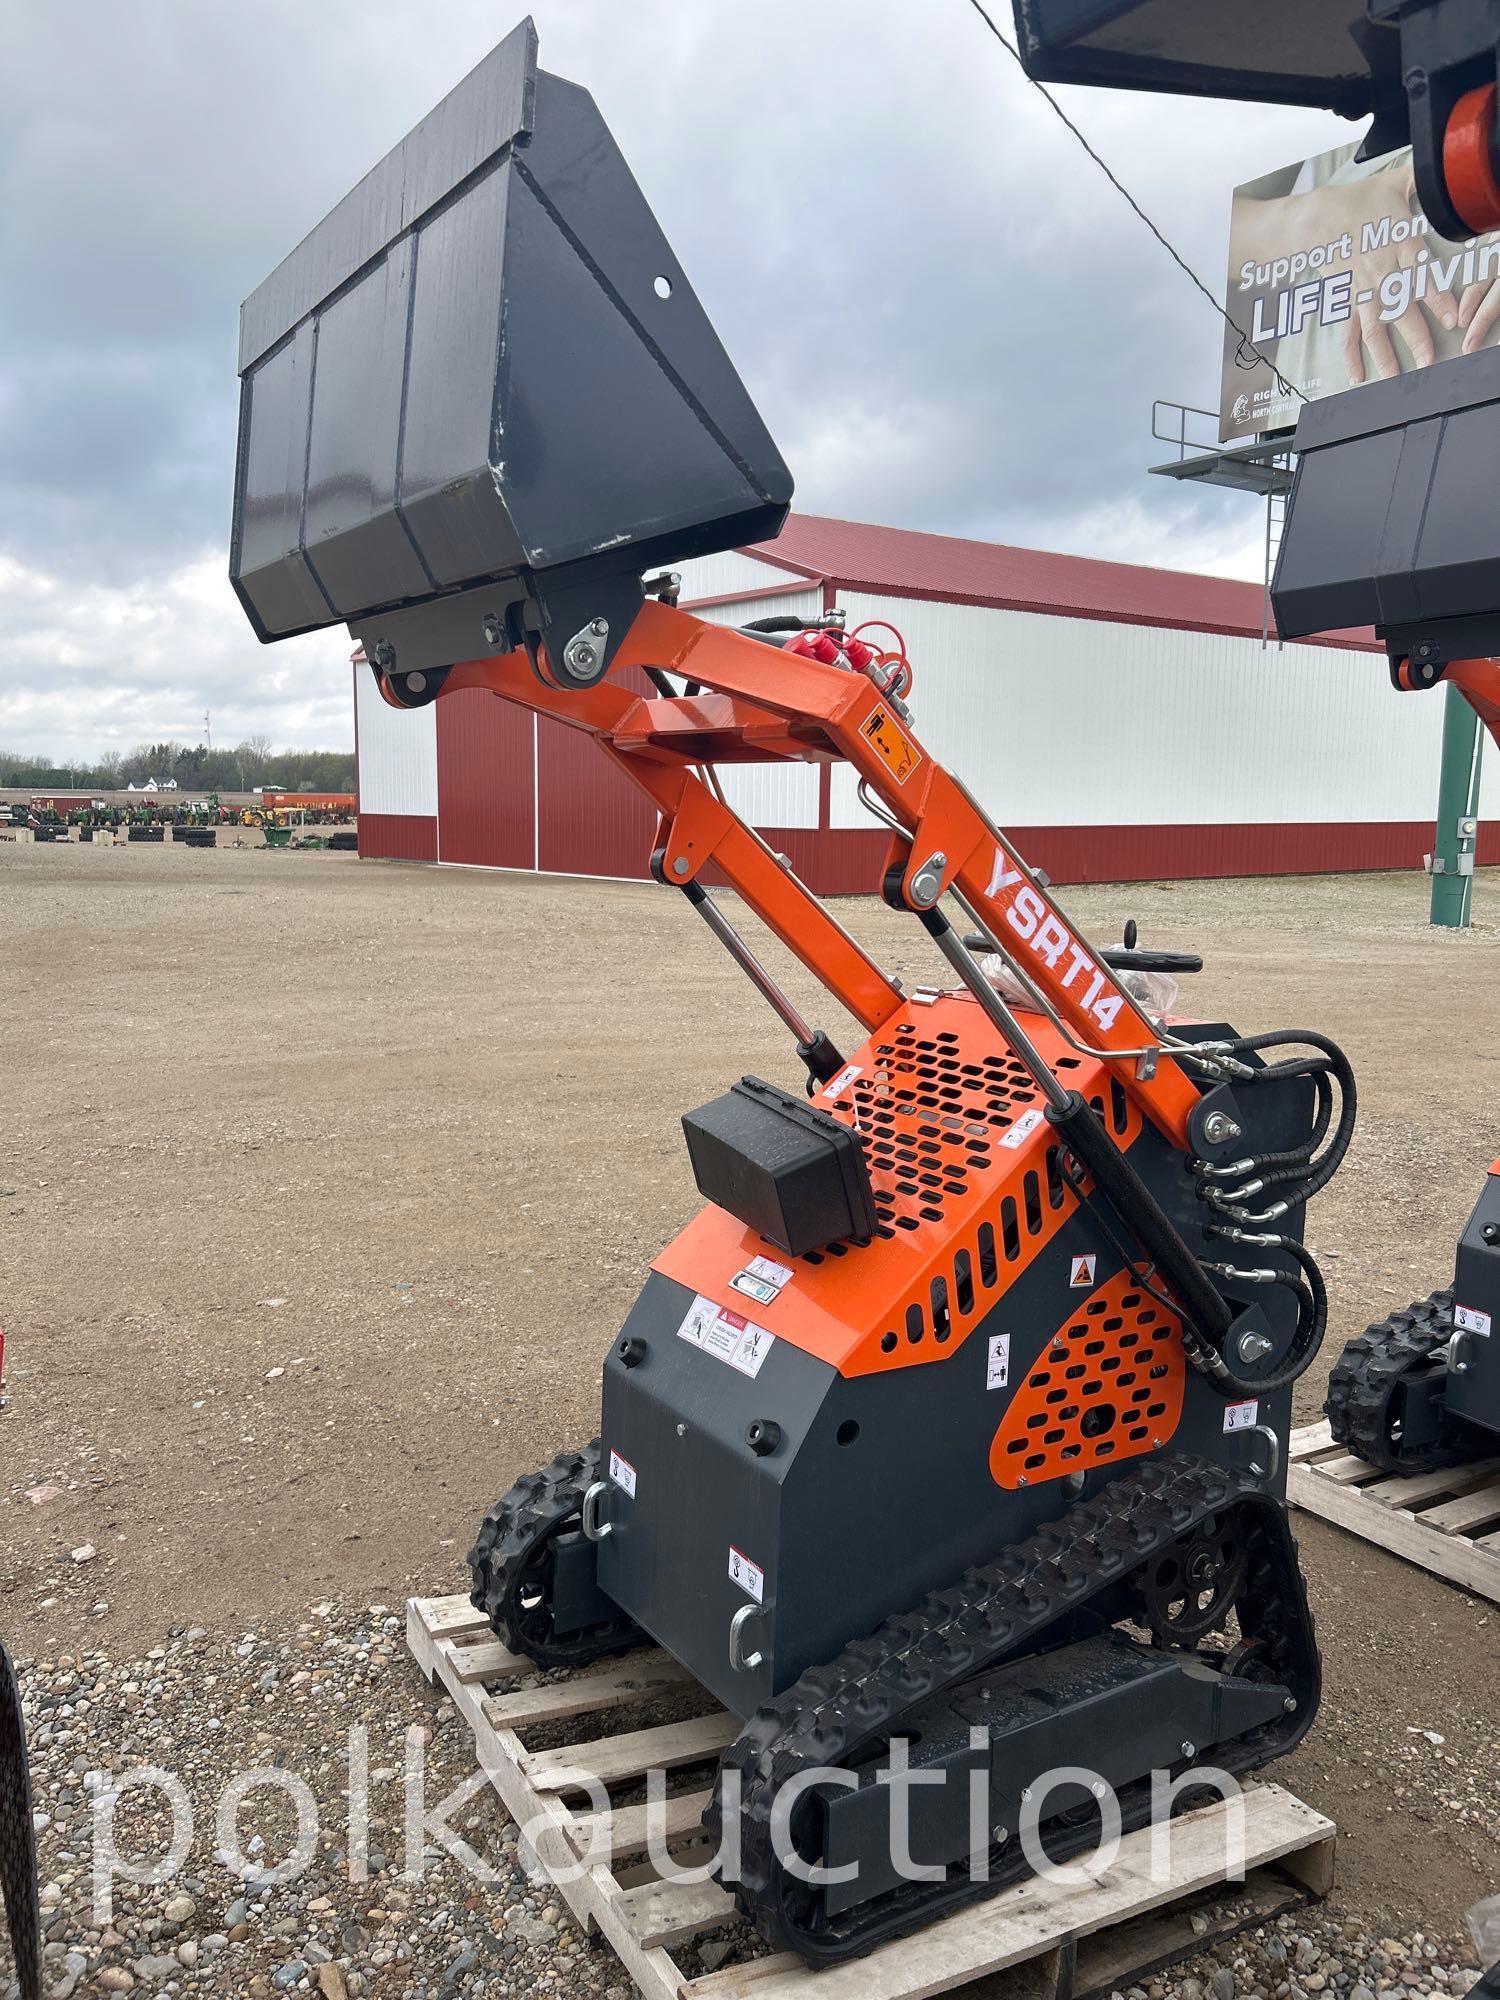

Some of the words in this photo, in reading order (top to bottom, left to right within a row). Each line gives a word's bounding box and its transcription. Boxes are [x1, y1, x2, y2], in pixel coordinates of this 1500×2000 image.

[1239, 233, 1352, 290] Support
[1361, 212, 1434, 254] Mon
[983, 848, 1124, 1032] YSRT14
